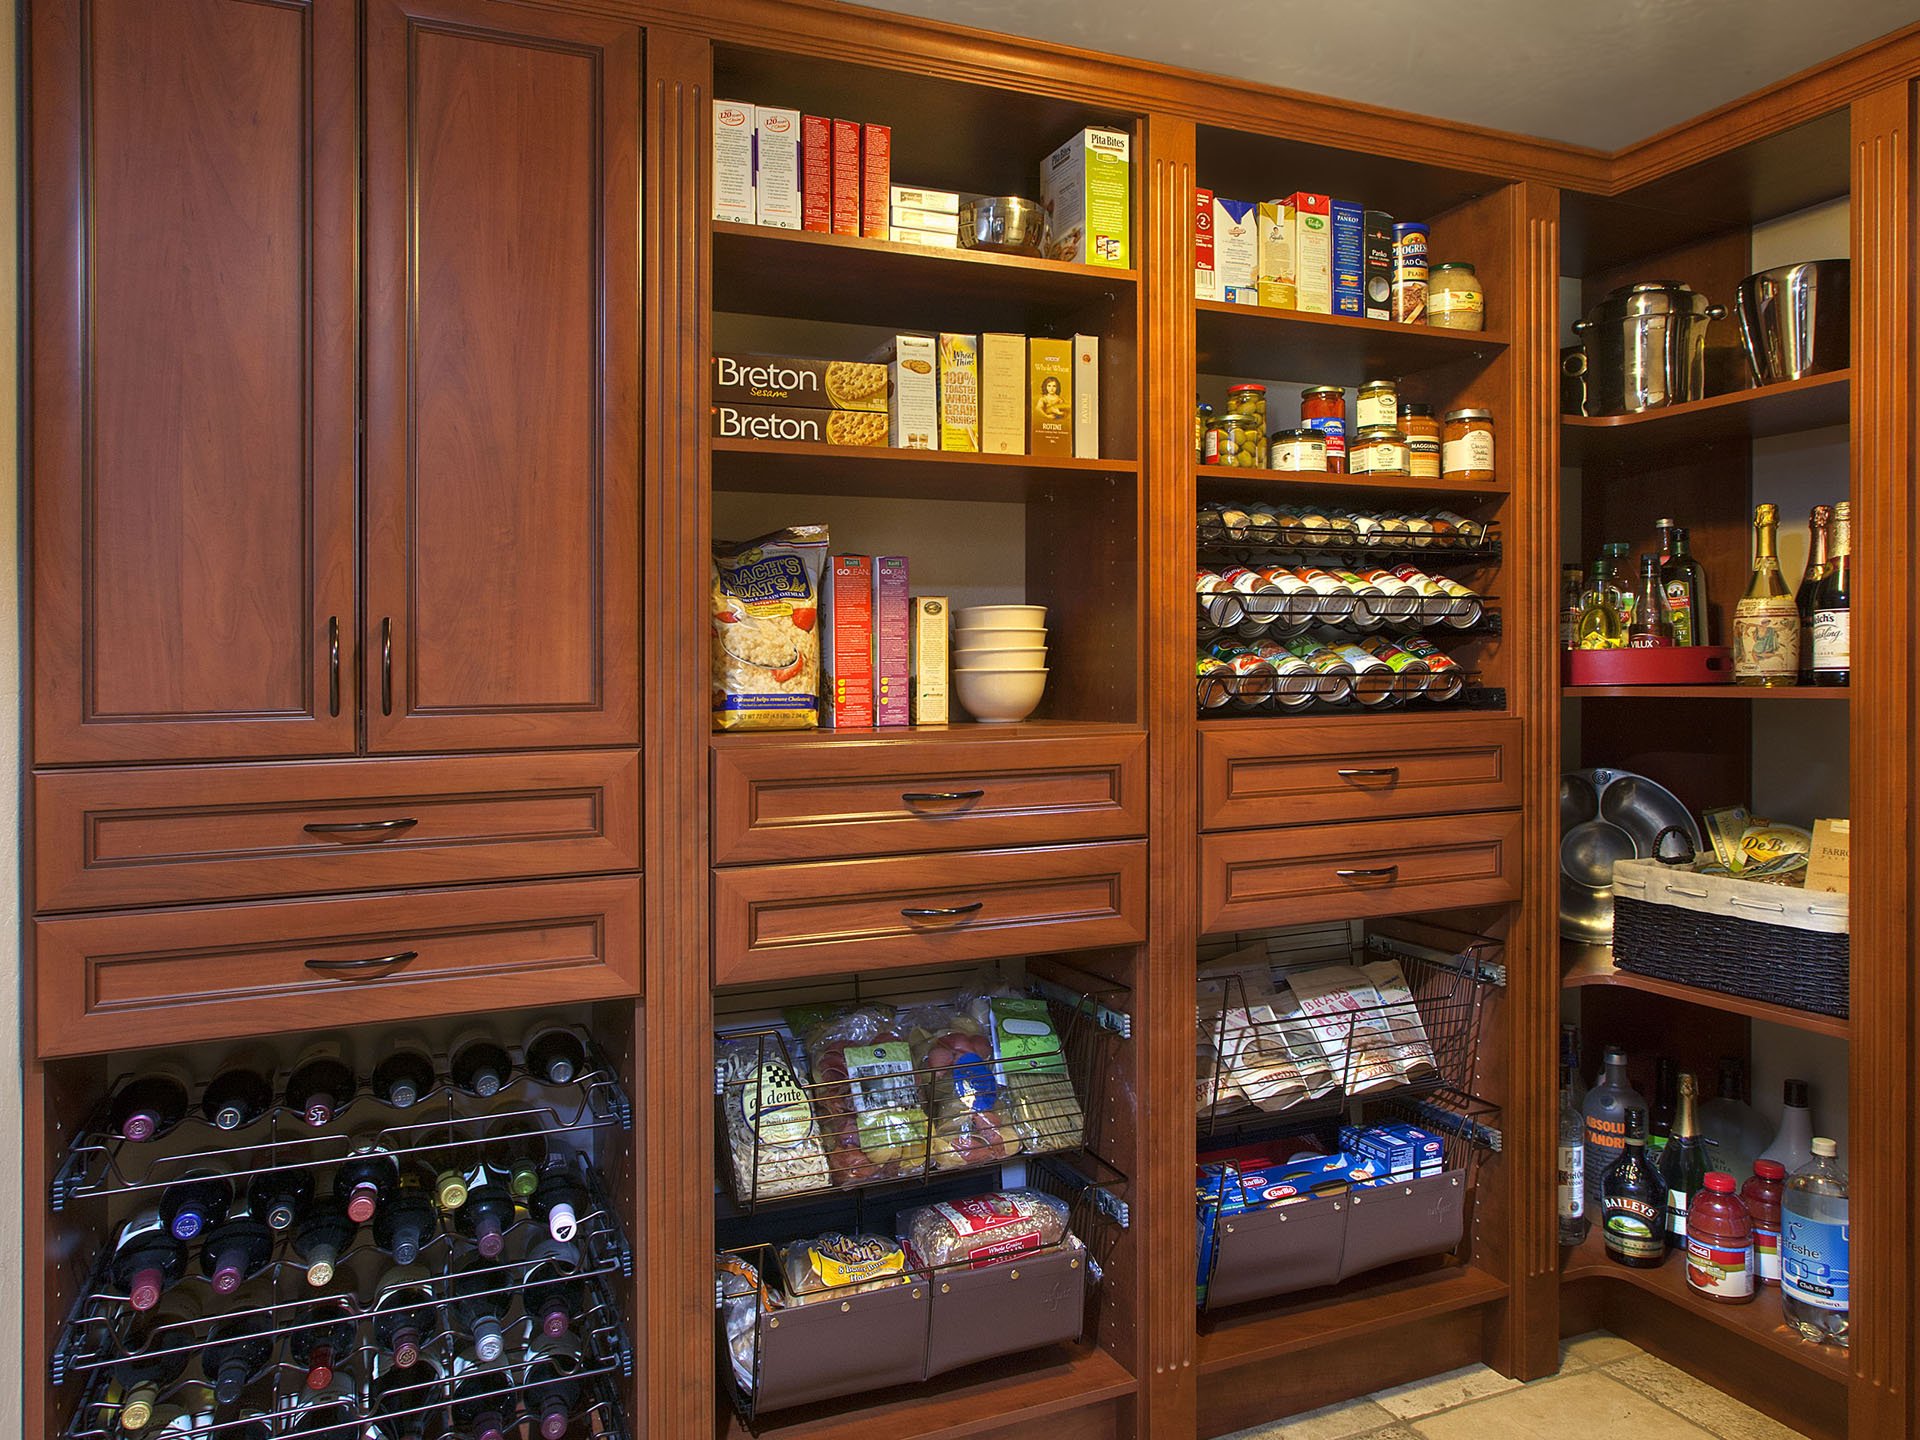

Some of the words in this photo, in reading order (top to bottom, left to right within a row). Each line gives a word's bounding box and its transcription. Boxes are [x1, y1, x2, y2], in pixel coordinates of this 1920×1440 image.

[1091, 133, 1106, 145] Pita
[1106, 136, 1125, 148] Bites
[1371, 249, 1388, 258] Panko
[718, 357, 817, 391] Breton
[943, 371, 976, 385] 100%
[750, 386, 788, 399] Sesame
[944, 394, 976, 404] WHOLE
[945, 404, 977, 416] GRAIN
[720, 407, 819, 440] Breton
[1630, 640, 1653, 648] VILUX
[1303, 987, 1350, 1011] BRAD'S
[767, 1089, 802, 1105] dente
[224, 1113, 234, 1124] T
[1586, 1115, 1626, 1134] ABSOLU
[1242, 1177, 1265, 1187] Barilla
[1270, 1187, 1294, 1198] Barilla
[1604, 1197, 1656, 1218] BAILEYS
[1799, 1281, 1814, 1290] Club
[1815, 1285, 1832, 1294] Soda
